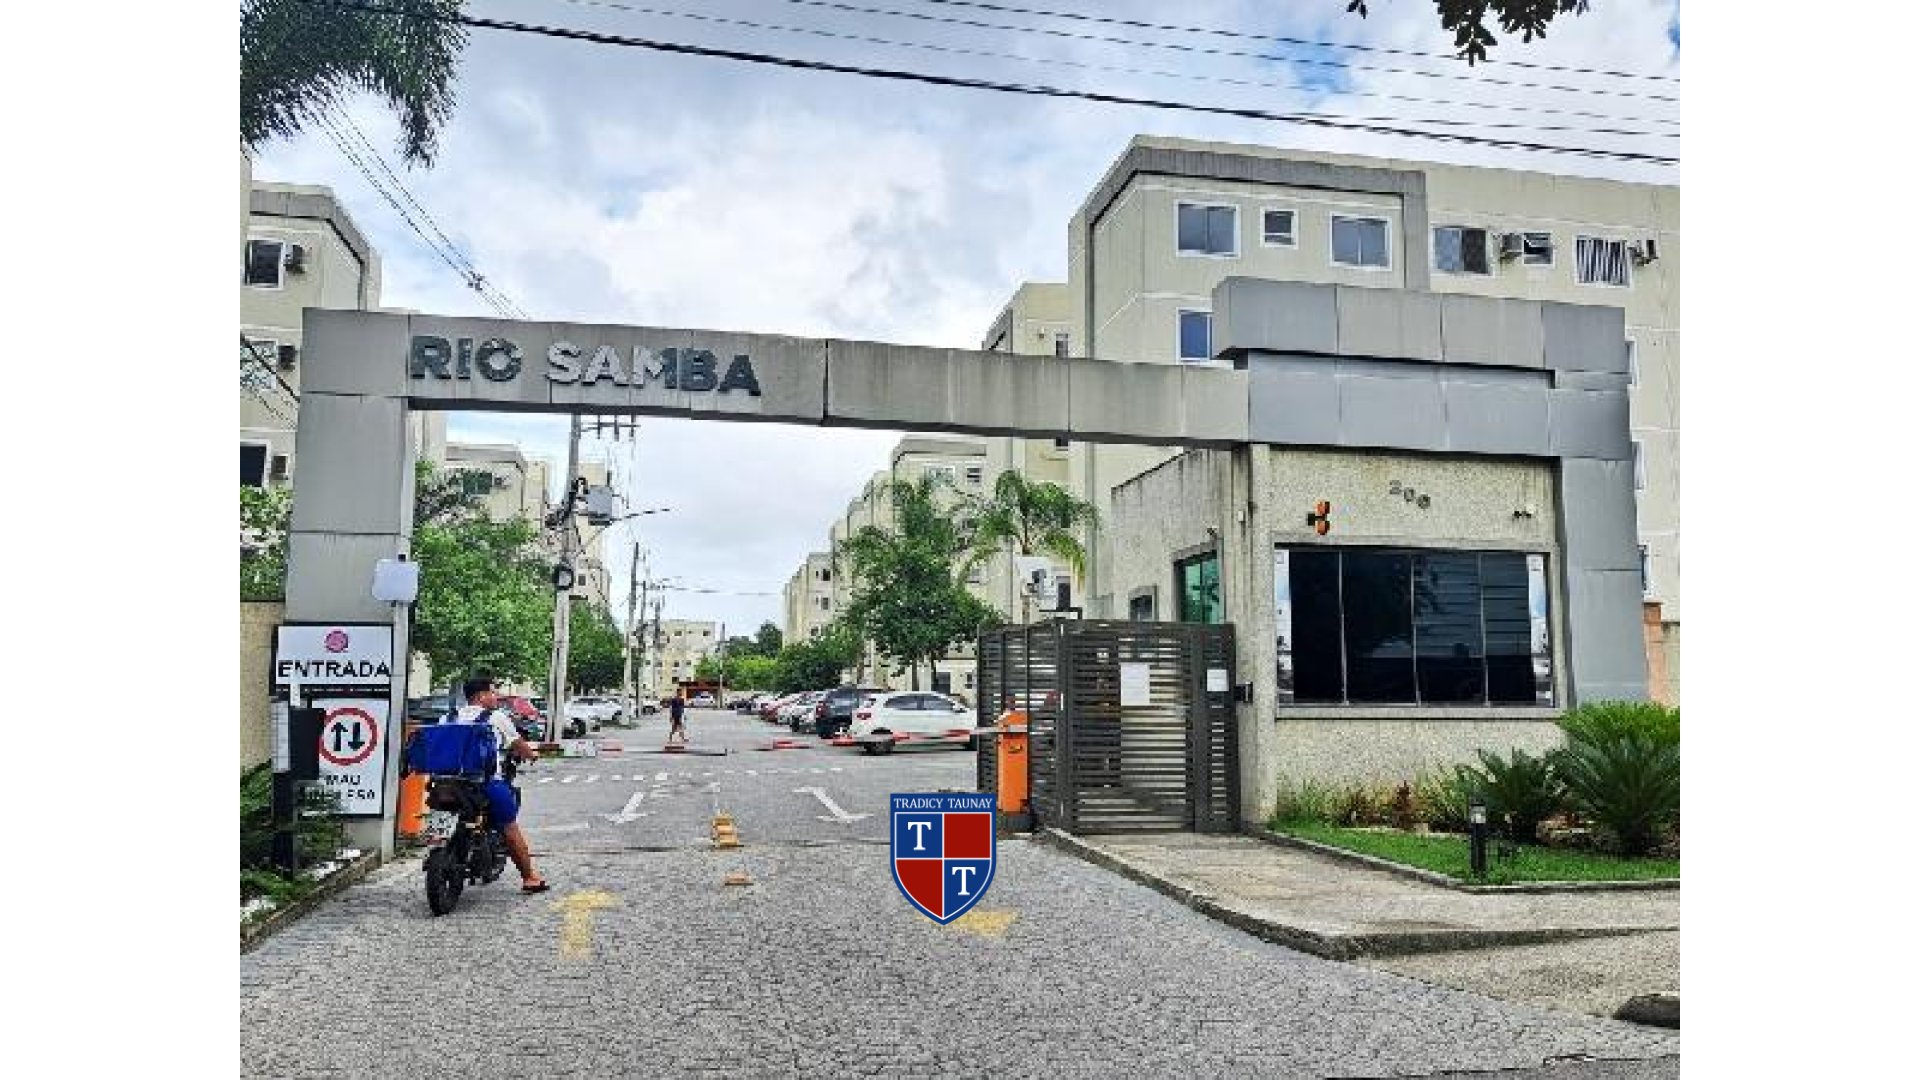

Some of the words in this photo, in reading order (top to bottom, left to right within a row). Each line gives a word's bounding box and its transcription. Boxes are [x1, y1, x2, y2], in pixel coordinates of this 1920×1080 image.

[410, 335, 522, 381] RIO
[546, 340, 761, 396] SAMBA
[278, 660, 392, 678] ENTRADA
